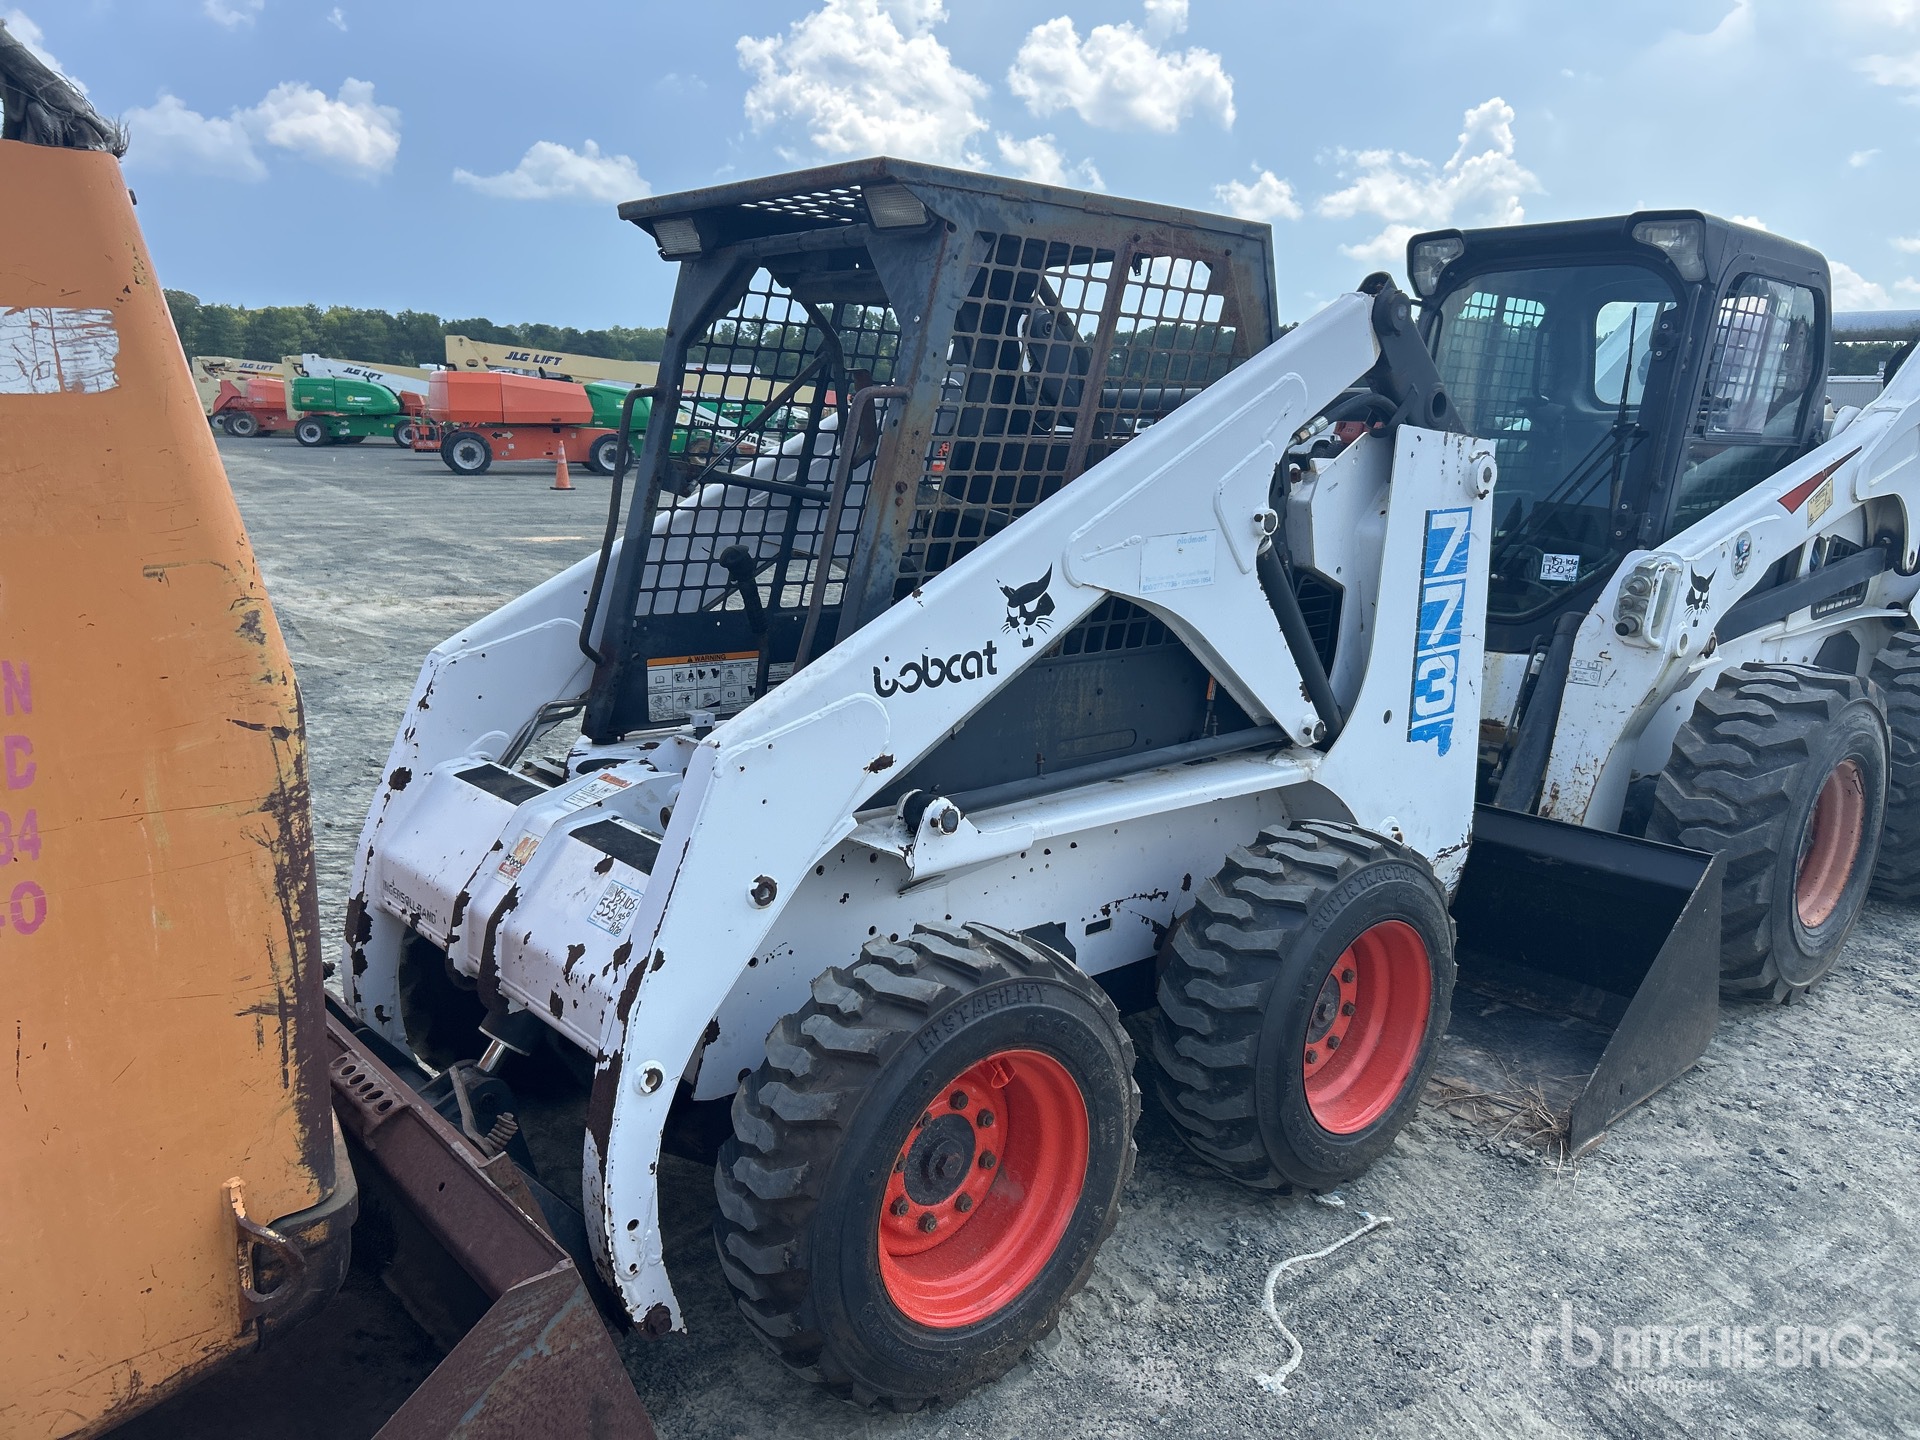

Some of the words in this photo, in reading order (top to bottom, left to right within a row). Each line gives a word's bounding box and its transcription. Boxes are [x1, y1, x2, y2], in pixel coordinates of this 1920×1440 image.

[504, 351, 530, 361] JLG
[532, 354, 563, 365] LIFT
[342, 366, 361, 376] JLG
[362, 371, 383, 380] LIFT
[694, 653, 727, 662] WARNING
